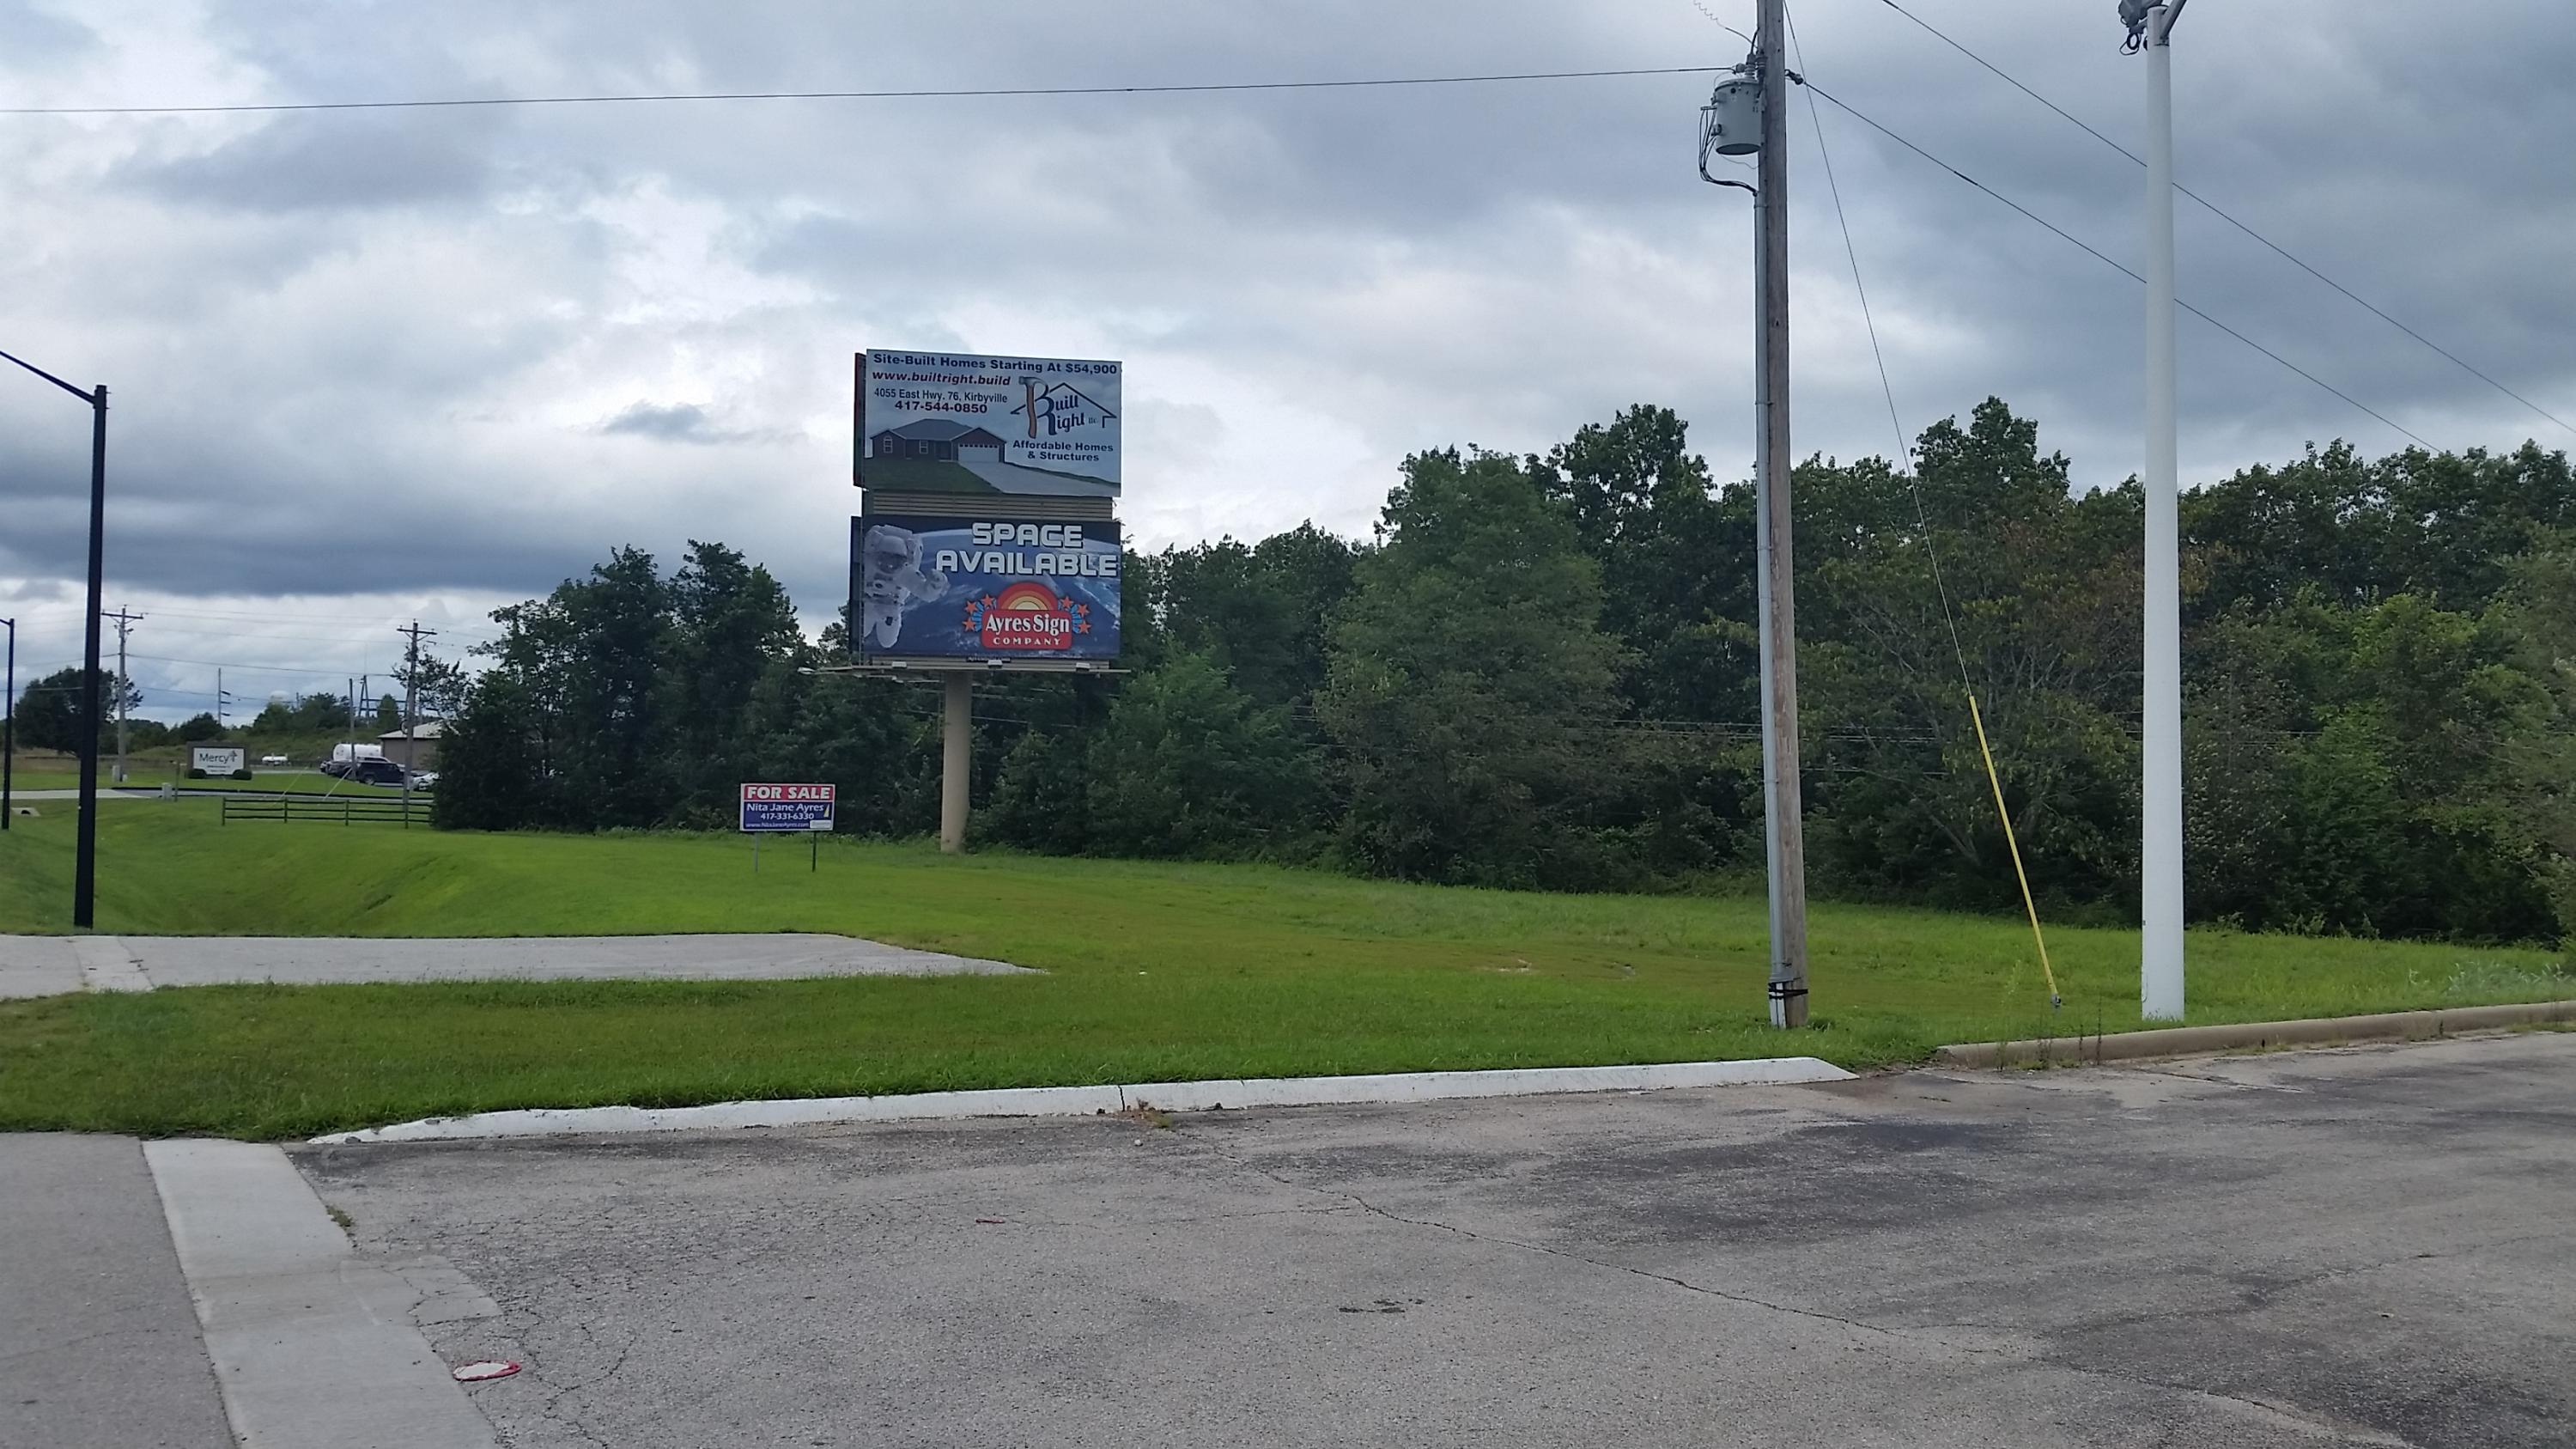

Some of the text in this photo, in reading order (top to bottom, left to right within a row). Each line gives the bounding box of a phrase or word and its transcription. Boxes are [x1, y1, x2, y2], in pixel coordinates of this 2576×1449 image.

[873, 353, 1117, 375] Site-Built Homes Starting At $54,900
[872, 371, 1012, 386] www.builtright.build
[874, 387, 1008, 405] 4055 East Hwy. 76, Kirbyville
[894, 400, 988, 414] 417-544-0850
[1012, 440, 1114, 453] Affordable Homes
[1027, 451, 1100, 462] & Structures
[972, 522, 1084, 549] SPACE
[936, 550, 1118, 577] AVAILABLE
[986, 613, 1070, 636] Ayres Sign
[993, 636, 1061, 646] COMPANY
[199, 752, 229, 764] Mercy
[747, 786, 831, 800] FOR SALE
[746, 803, 824, 813] Nita Jane Ayres
